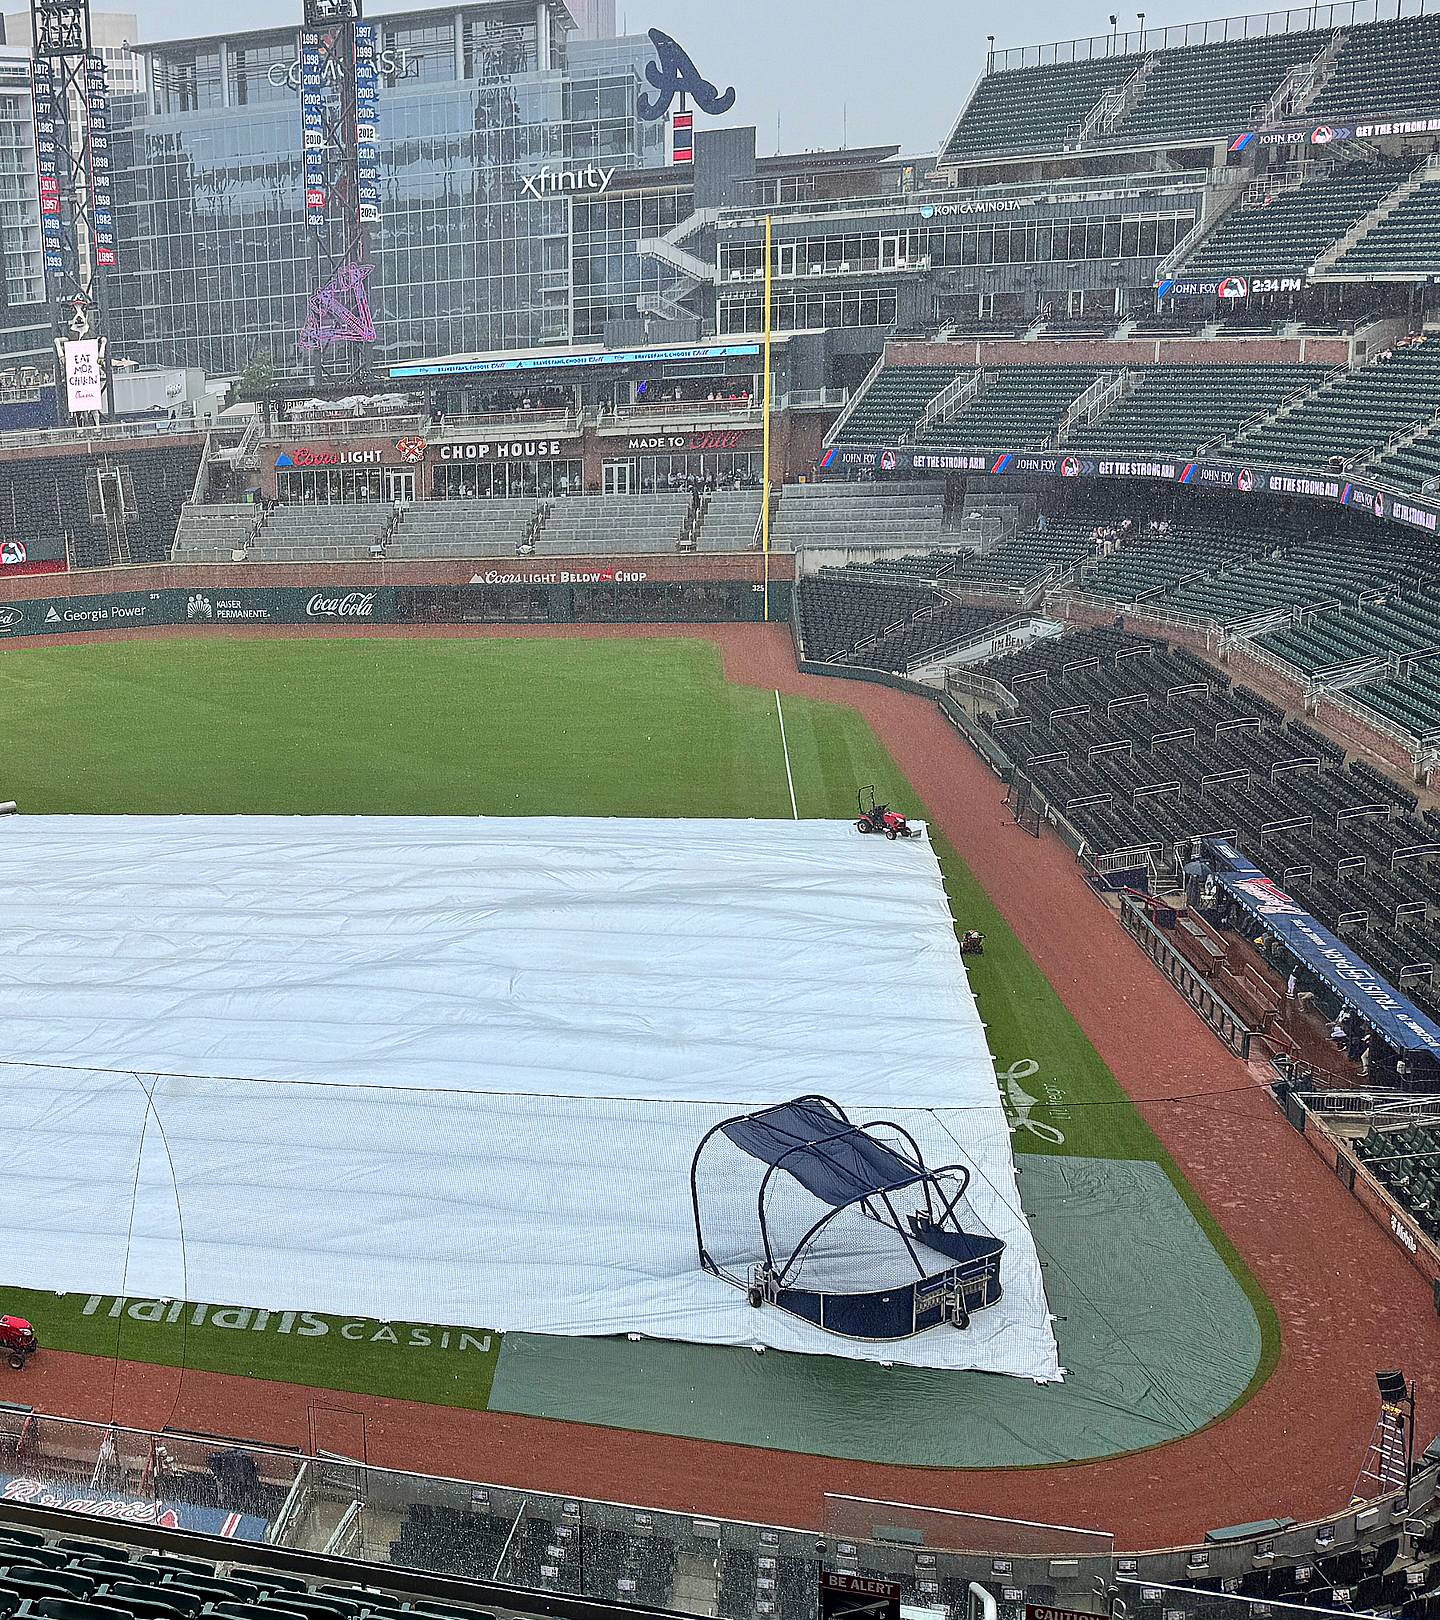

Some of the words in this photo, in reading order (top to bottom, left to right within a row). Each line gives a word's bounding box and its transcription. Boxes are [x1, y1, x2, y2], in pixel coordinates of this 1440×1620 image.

[1355, 126, 1373, 138] GET
[1374, 124, 1392, 135] THE
[1392, 121, 1427, 134] STRONG
[1258, 133, 1286, 145] JOHN
[520, 162, 616, 199] xfinity
[933, 203, 974, 217] KONICA
[976, 199, 1021, 214] MINOLTA
[1171, 283, 1197, 295] JOHN
[1252, 279, 1279, 293] 2:34
[1280, 278, 1302, 292] PM
[440, 444, 490, 460] CHOP
[497, 440, 561, 458] HOUSE
[628, 437, 666, 450] MADE
[668, 437, 685, 448] TO
[340, 450, 383, 464] LIGHT
[841, 453, 863, 464] JOHN
[913, 455, 926, 467] GET
[926, 456, 940, 468] THE
[1016, 458, 1039, 470] JOHN
[484, 570, 523, 584] Coors
[523, 573, 557, 583] LIGHT
[560, 571, 600, 583] BELOW
[614, 570, 647, 582] CHOP
[216, 600, 242, 609] KAISER
[63, 609, 109, 623] Georgia
[111, 606, 147, 619] Power
[217, 609, 268, 619] PERMANENTE
[828, 1575, 848, 1589] BE
[850, 1578, 895, 1596] ALERT
